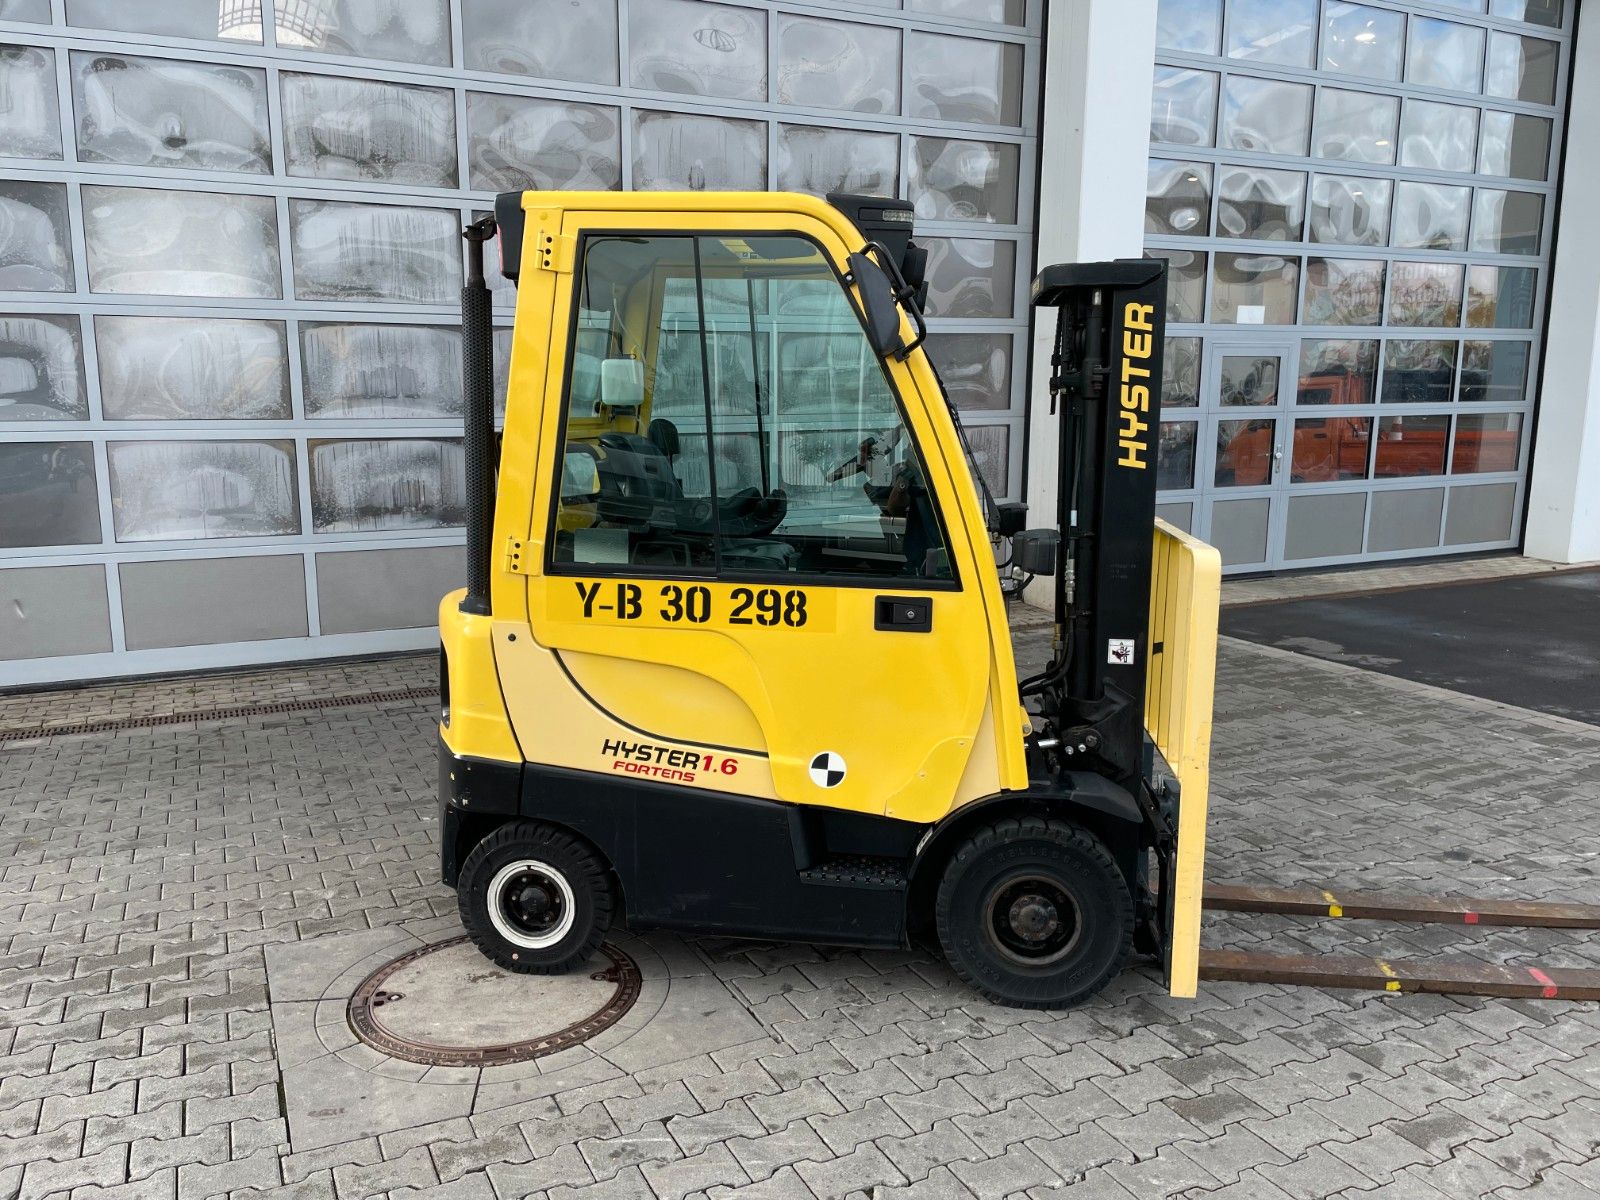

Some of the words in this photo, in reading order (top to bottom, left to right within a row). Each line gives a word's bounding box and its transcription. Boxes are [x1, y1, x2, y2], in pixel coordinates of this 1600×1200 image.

[1118, 302, 1154, 470] HYSTER
[574, 582, 643, 620] Y-B
[659, 585, 711, 623] 30
[728, 587, 808, 628] 298
[601, 738, 701, 770] HYSTER
[702, 754, 739, 776] 1.6
[612, 760, 696, 783] FORTENS
